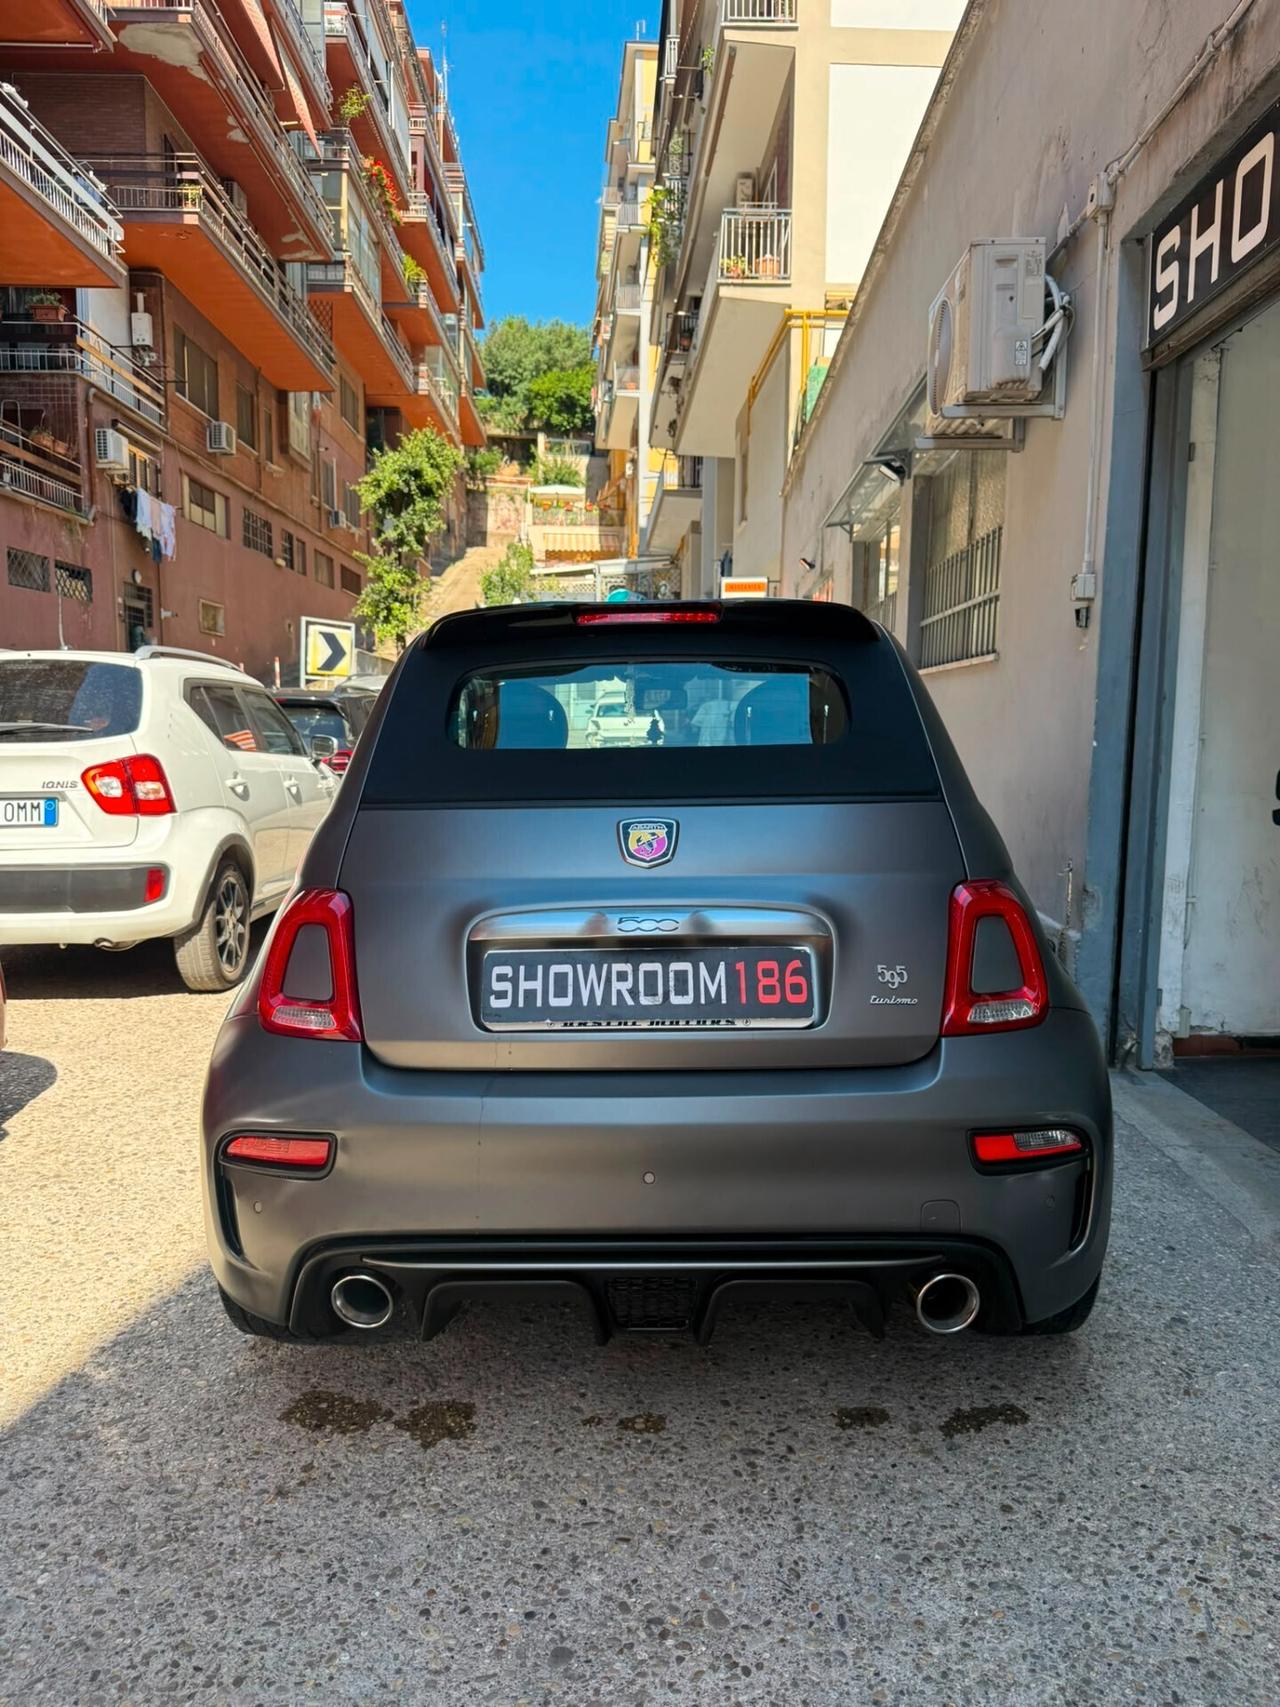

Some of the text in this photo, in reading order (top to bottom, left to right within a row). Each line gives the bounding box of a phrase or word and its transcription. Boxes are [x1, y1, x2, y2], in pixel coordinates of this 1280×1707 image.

[1153, 131, 1275, 331] SHO
[41, 780, 79, 789] IGNIS
[617, 916, 680, 932] 500
[877, 964, 908, 989] 595
